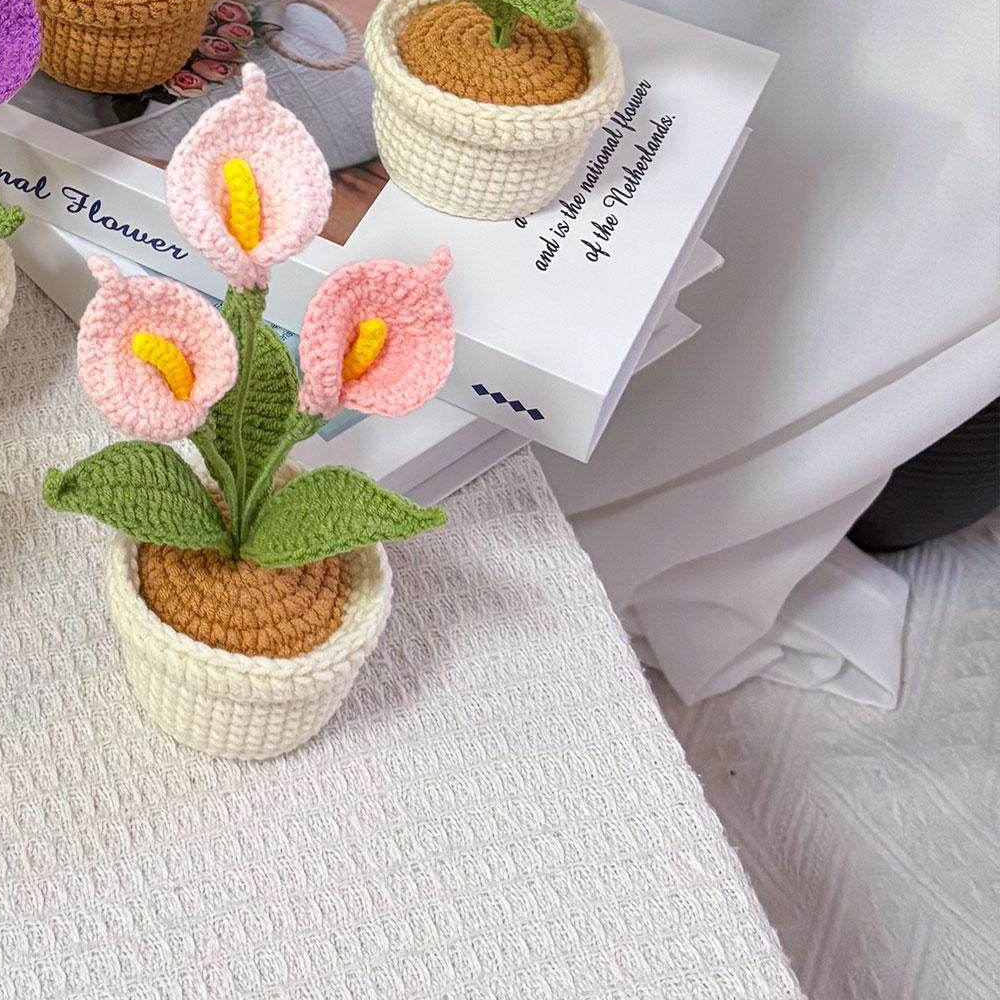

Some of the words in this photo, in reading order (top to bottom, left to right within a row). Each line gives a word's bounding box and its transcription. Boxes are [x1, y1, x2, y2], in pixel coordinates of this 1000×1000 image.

[611, 79, 652, 132] flower
[580, 126, 624, 193] national
[603, 114, 676, 207] Netherlands.
[62, 186, 188, 260] Flower
[559, 193, 586, 221] the
[549, 221, 570, 238] is
[590, 214, 619, 243] the
[535, 236, 560, 272] and
[580, 239, 611, 262] of
